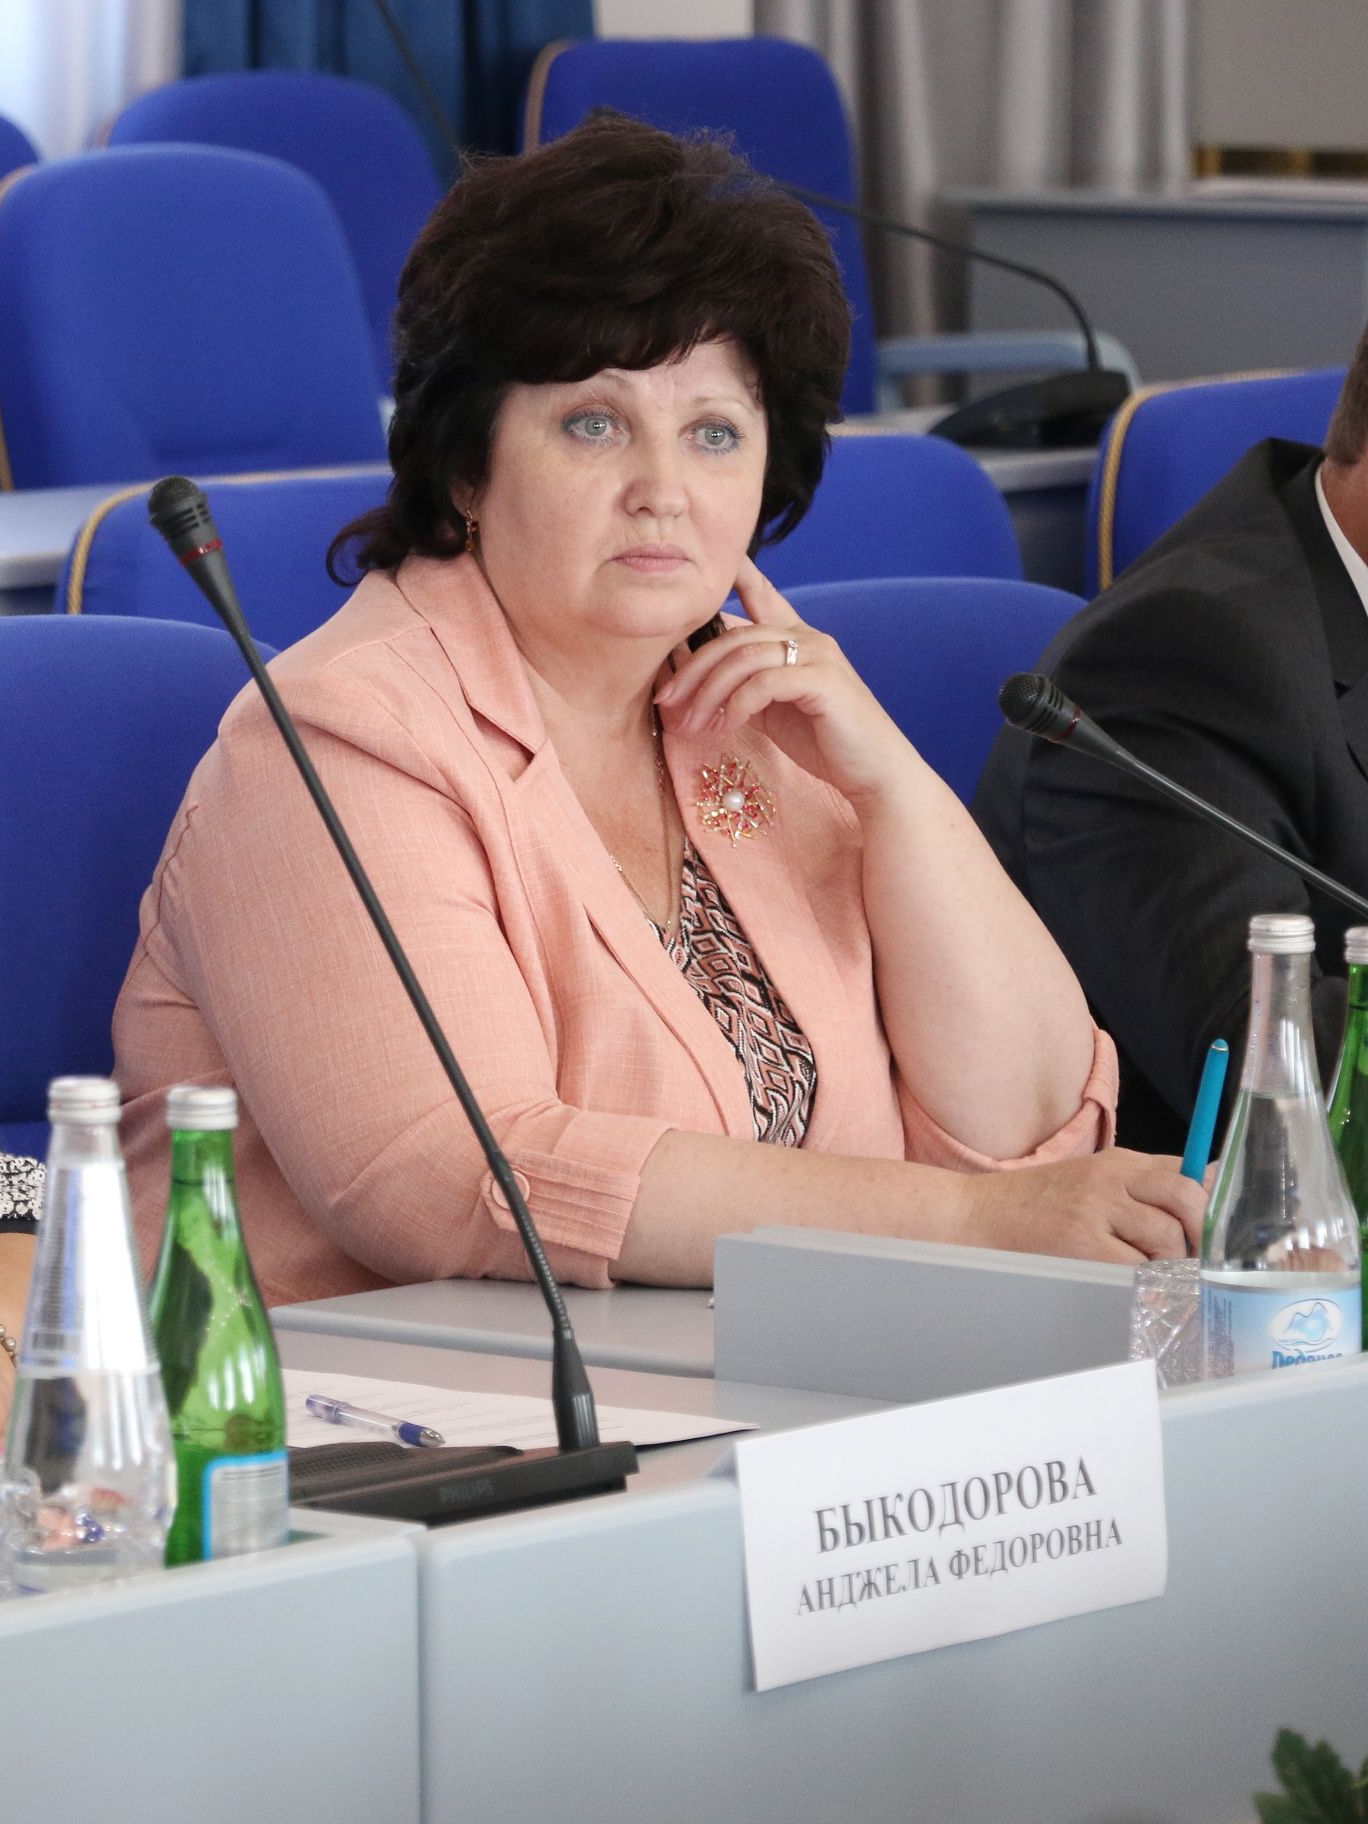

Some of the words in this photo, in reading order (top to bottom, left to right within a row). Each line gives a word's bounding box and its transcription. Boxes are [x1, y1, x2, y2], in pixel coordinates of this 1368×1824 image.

[439, 1479, 494, 1504] PHILIPS
[814, 1456, 1098, 1554] БЫКОДОРОВА
[796, 1556, 942, 1616] АНДЖЕЛА
[948, 1517, 1124, 1581] ФЕДОРОВНА
